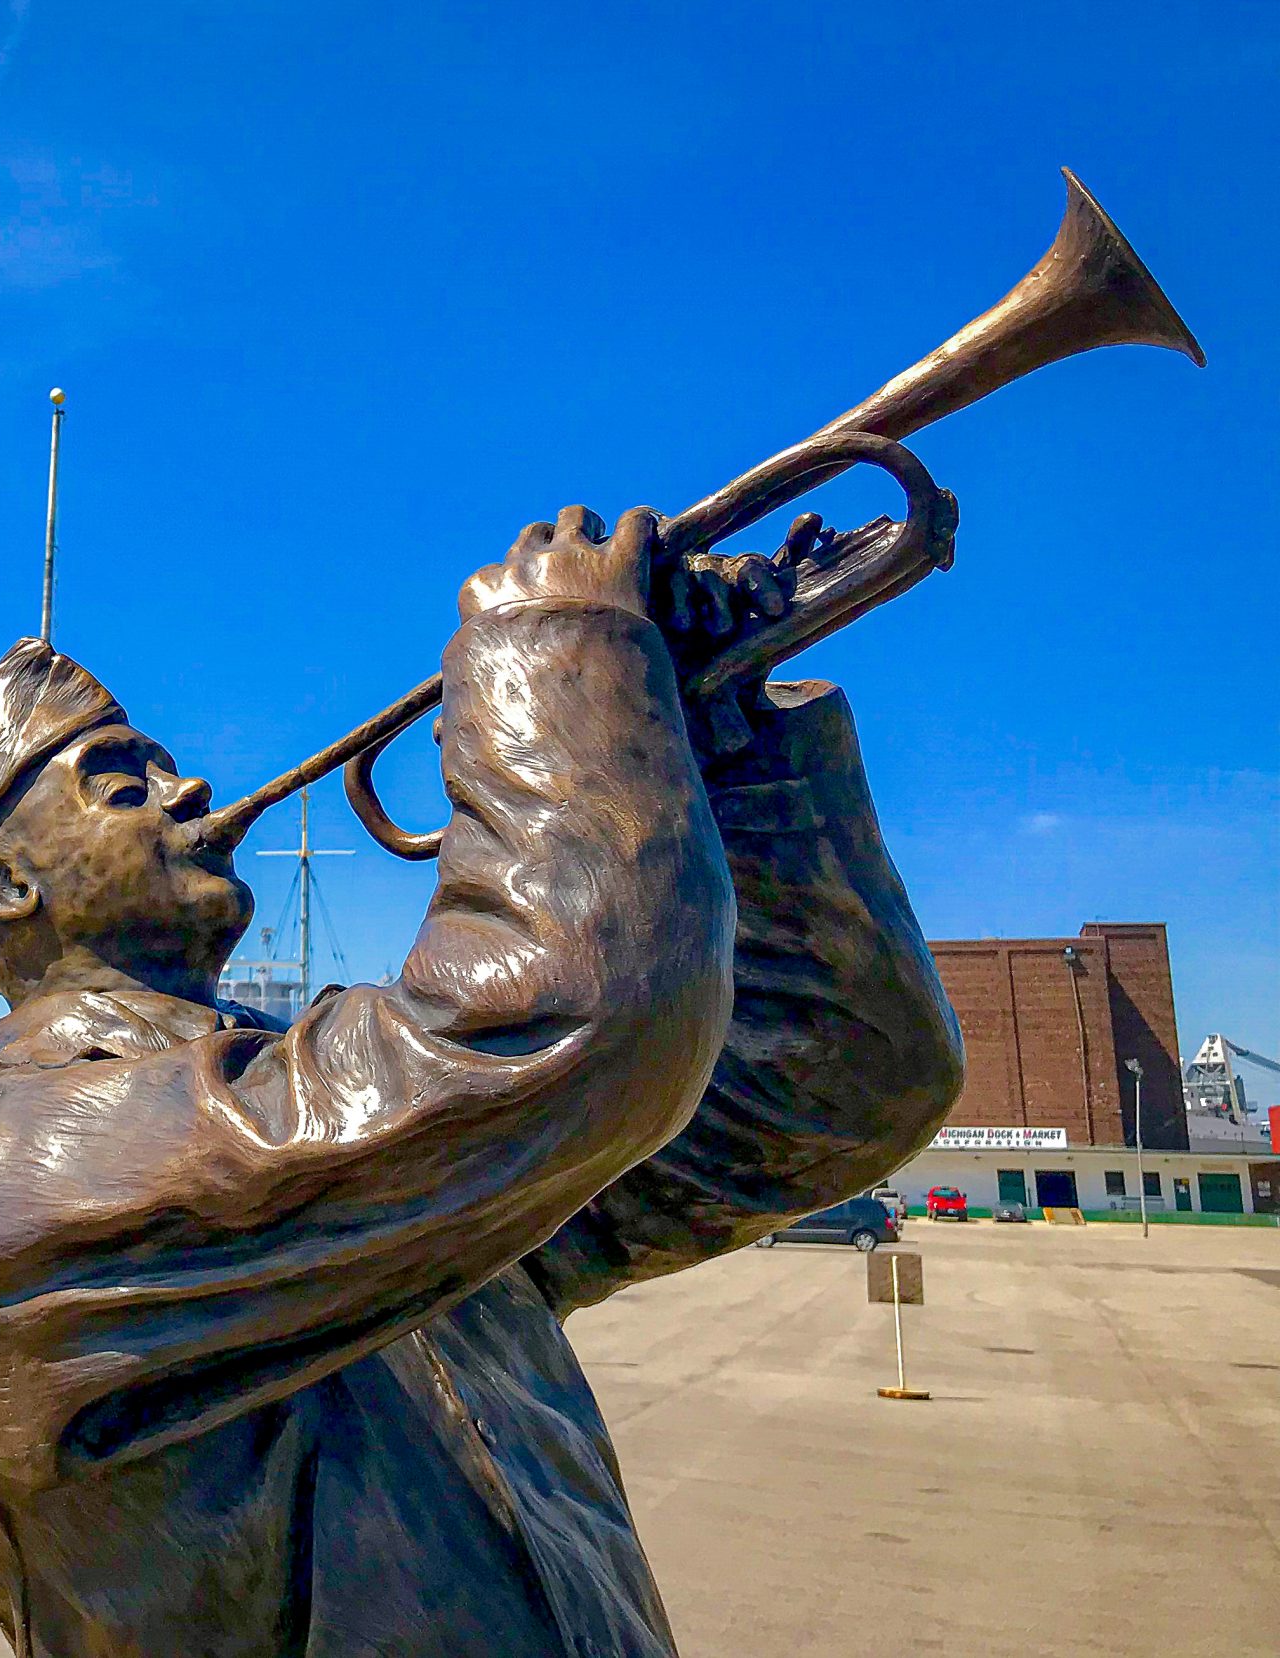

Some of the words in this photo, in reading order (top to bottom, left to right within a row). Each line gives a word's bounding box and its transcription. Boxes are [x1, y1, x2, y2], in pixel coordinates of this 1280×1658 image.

[939, 1128, 985, 1140] MICHIGAN
[987, 1128, 1013, 1140] DOCK
[1023, 1128, 1062, 1140] MARKET
